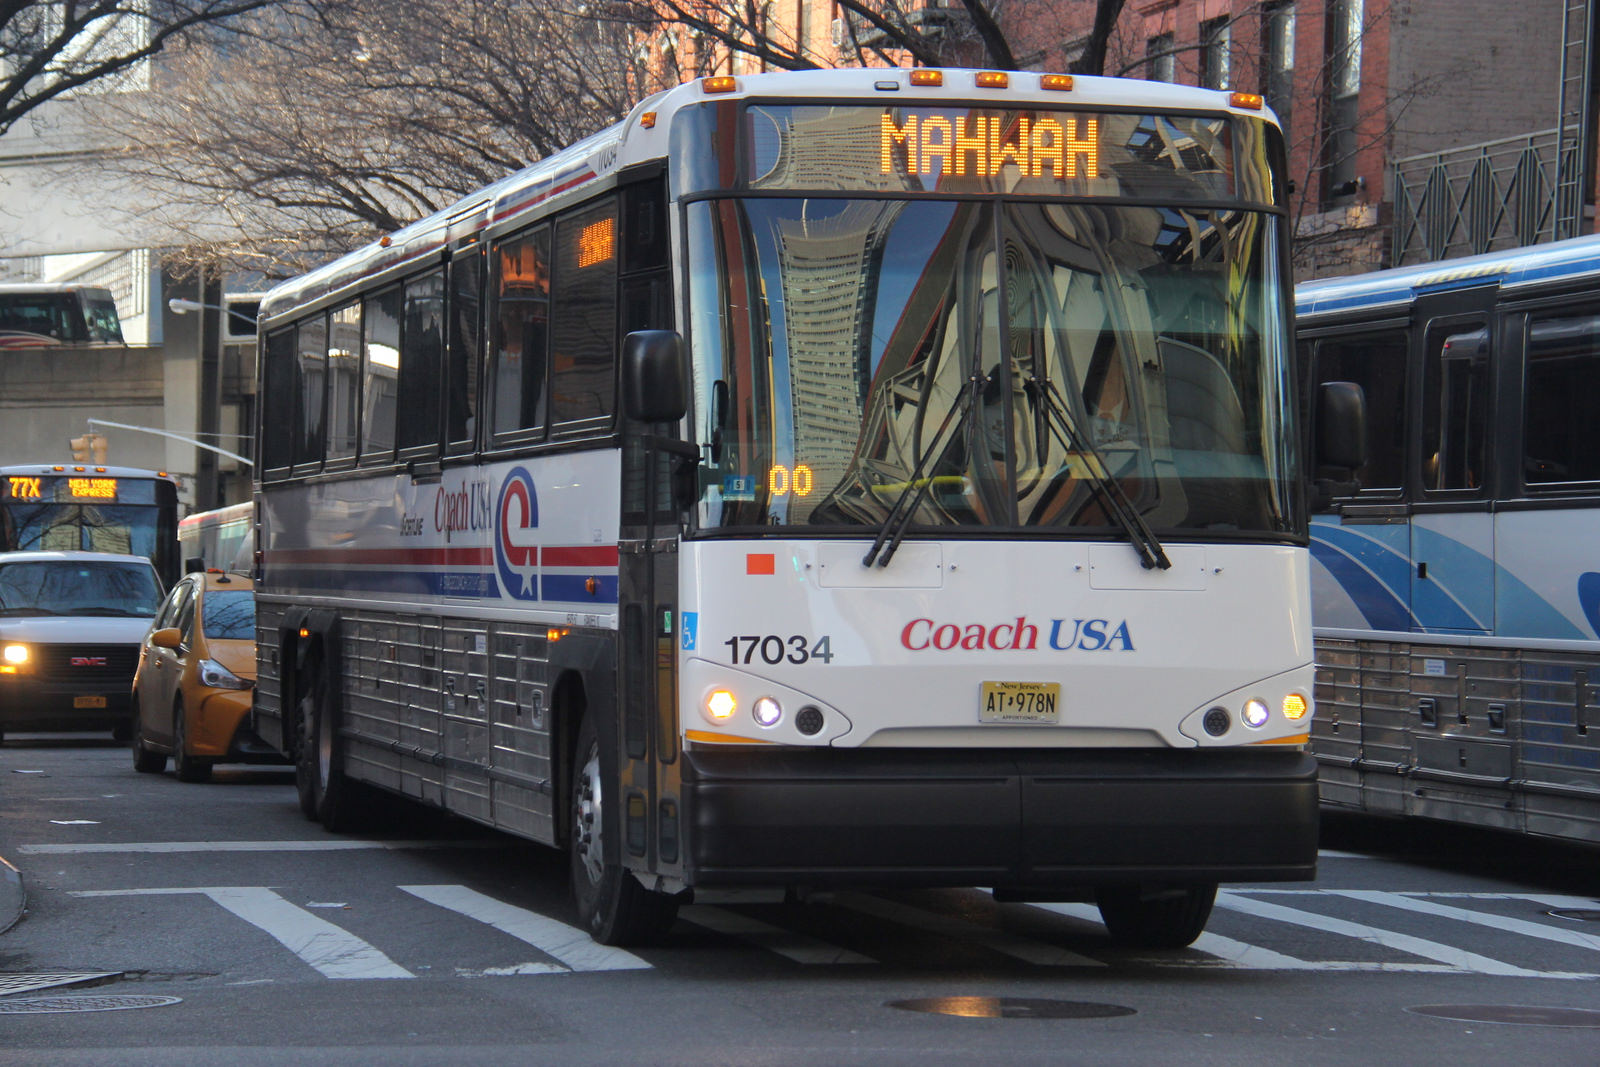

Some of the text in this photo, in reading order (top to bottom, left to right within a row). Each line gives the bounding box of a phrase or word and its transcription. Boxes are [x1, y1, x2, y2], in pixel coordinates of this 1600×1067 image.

[881, 114, 1097, 177] MAHWAH
[8, 476, 41, 498] 77X
[68, 478, 118, 489] NEW YORK
[71, 487, 116, 498] EXPRESS
[434, 480, 468, 532] Coach
[901, 616, 1136, 651] Coach USA
[71, 656, 107, 666] GMC
[724, 635, 834, 665] 17034
